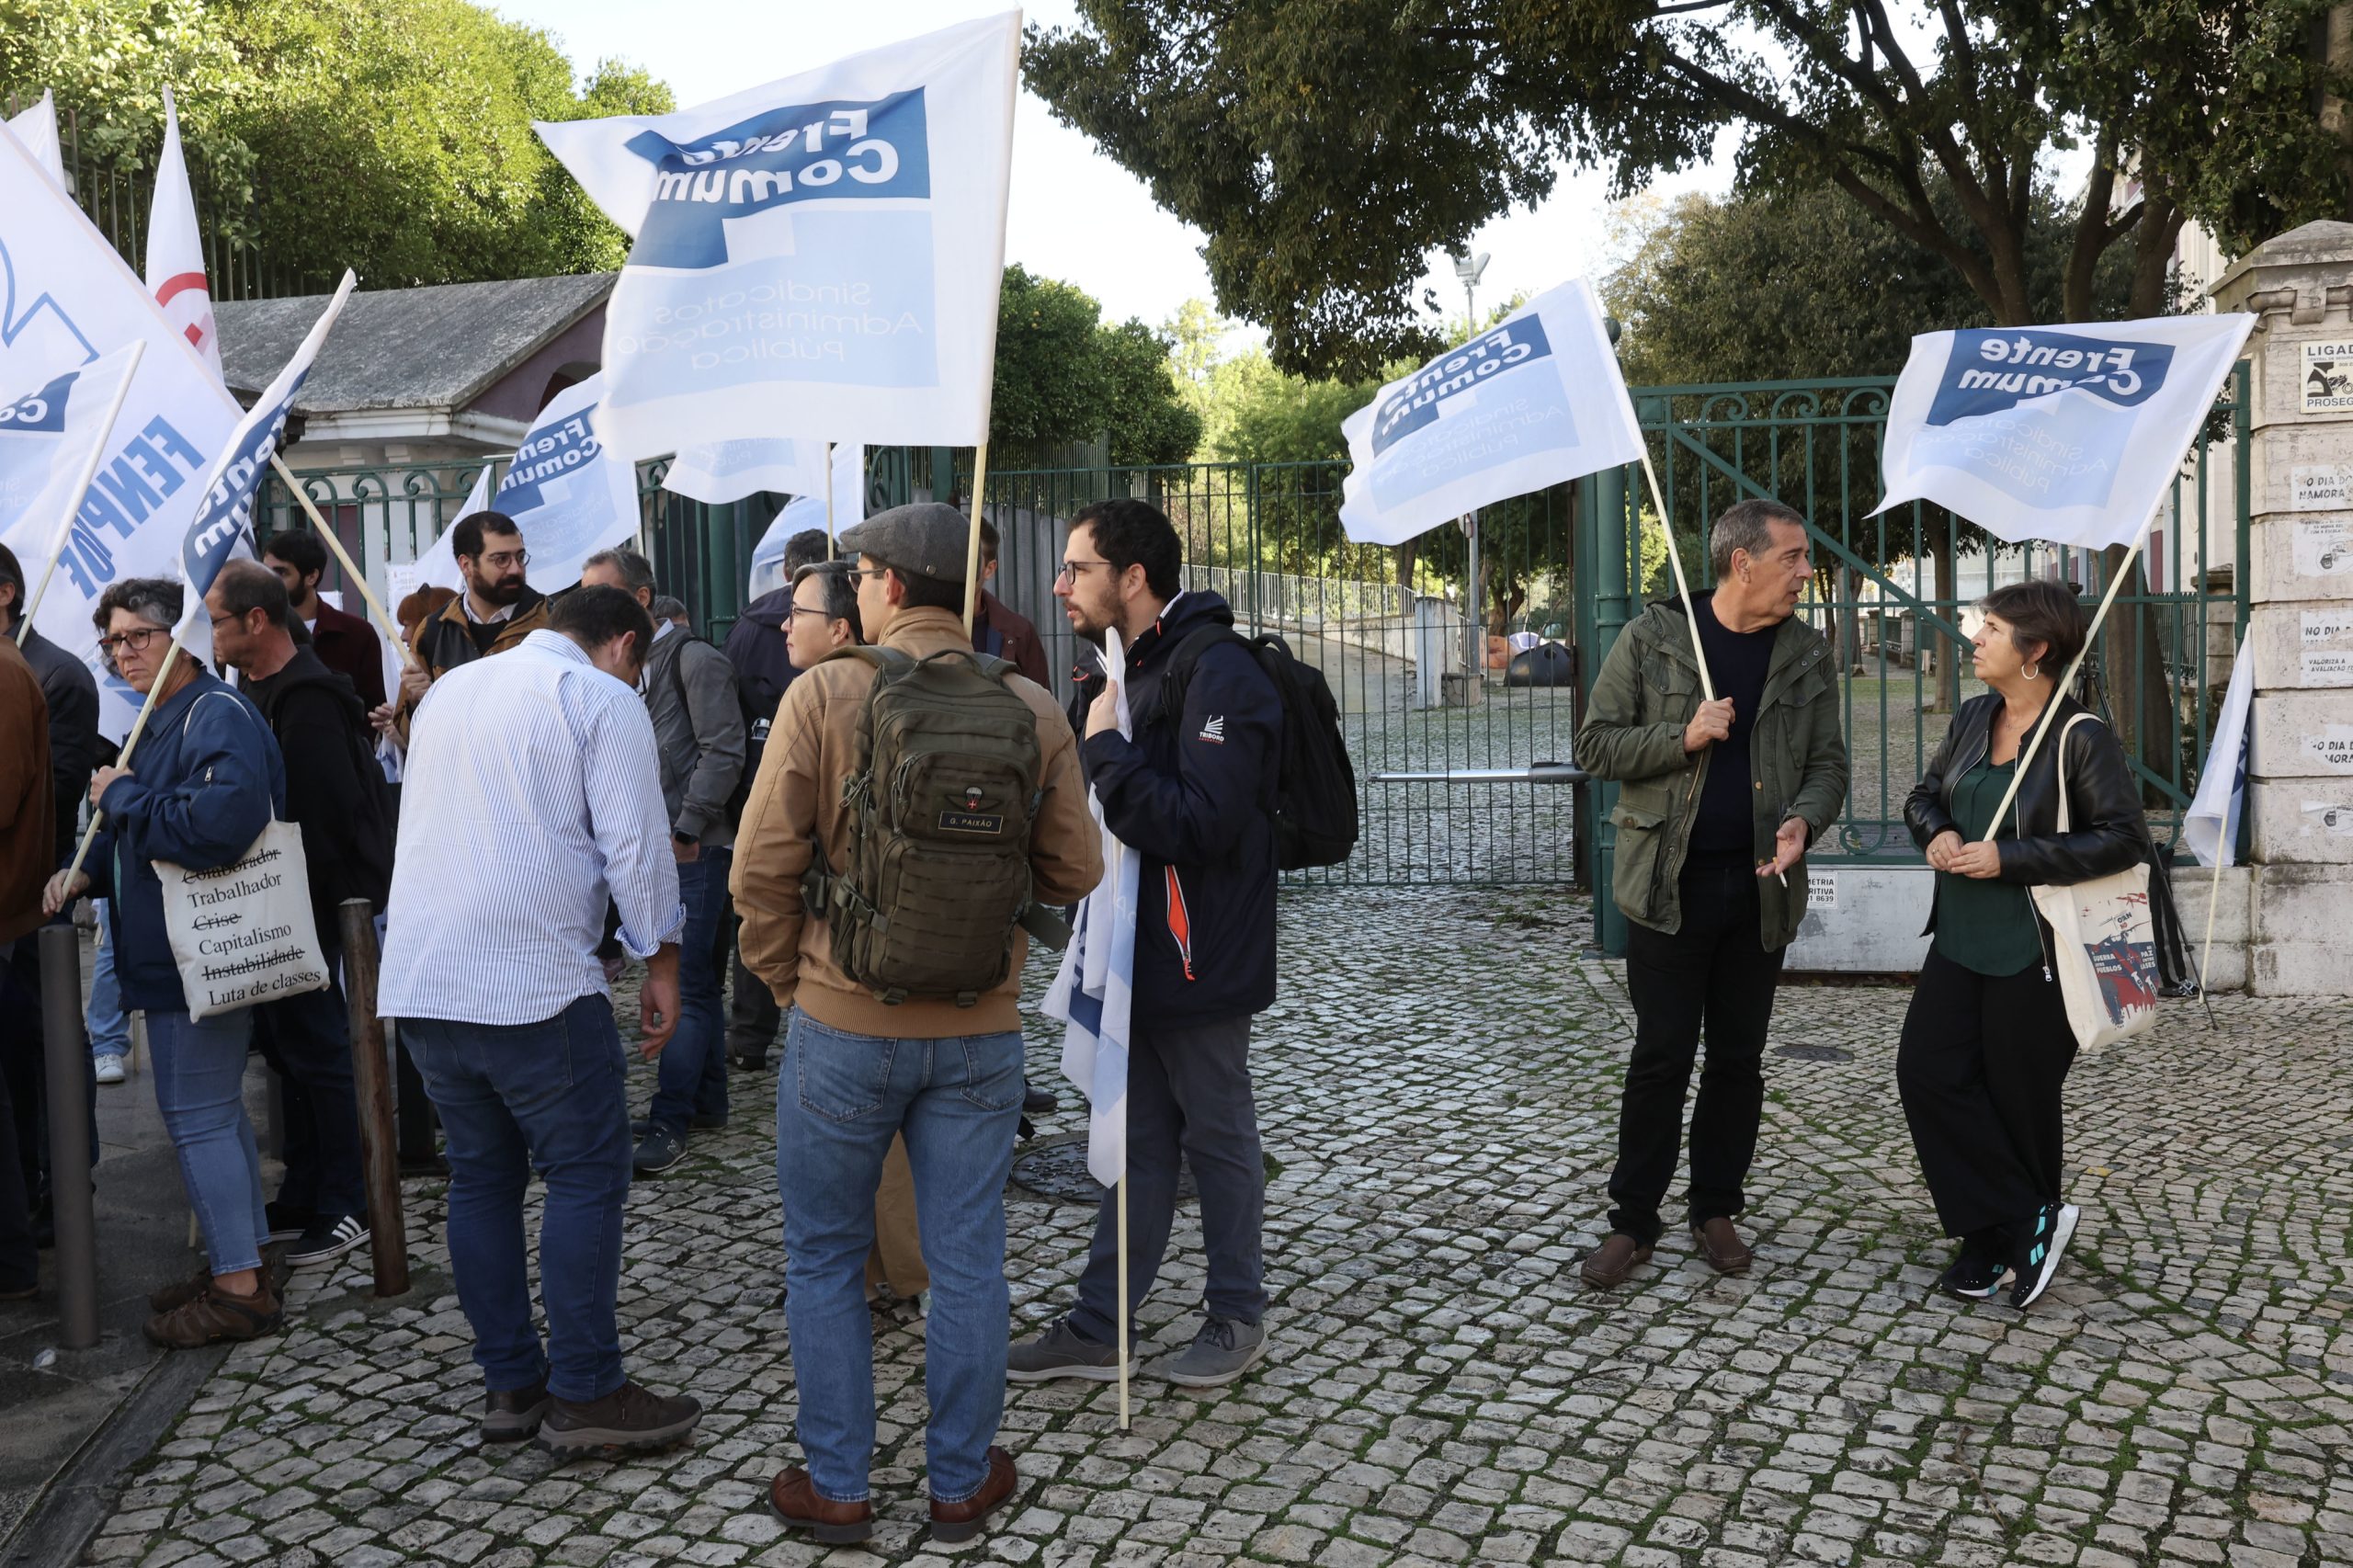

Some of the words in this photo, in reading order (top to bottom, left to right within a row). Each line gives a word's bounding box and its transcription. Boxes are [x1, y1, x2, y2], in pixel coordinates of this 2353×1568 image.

[2307, 396, 2353, 408] PROSEG
[2305, 626, 2321, 636] NO
[1199, 731, 1224, 742] TRIBORD
[2328, 741, 2346, 751] DIA
[187, 873, 282, 908] Trabalhador
[192, 912, 242, 931] Crise
[199, 924, 292, 956] Capitalismo
[2141, 949, 2154, 958] PAZ
[202, 945, 304, 982] Instabilidade
[209, 988, 245, 1006] Luta
[250, 981, 268, 997] de
[272, 971, 322, 991] classes
